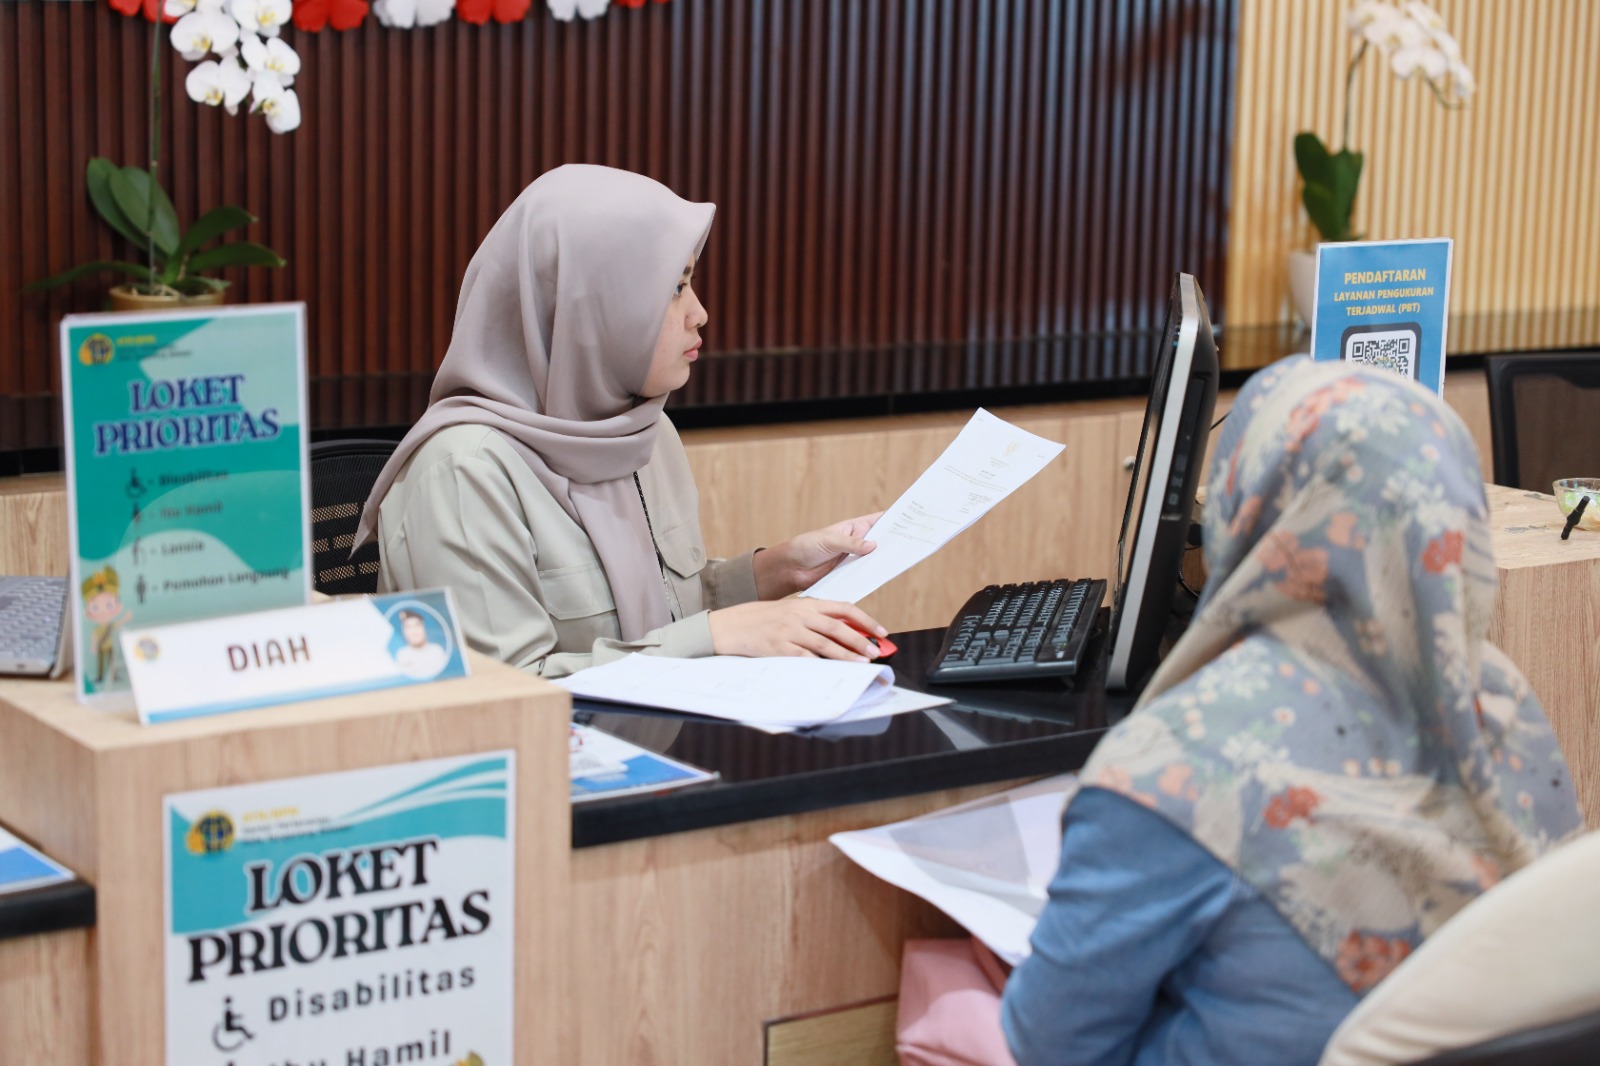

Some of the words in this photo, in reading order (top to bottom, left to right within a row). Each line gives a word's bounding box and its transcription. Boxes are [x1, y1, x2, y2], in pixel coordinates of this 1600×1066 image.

[1334, 291, 1375, 301] LAYANAN
[1378, 287, 1433, 298] PENGUKURAN
[1345, 269, 1426, 284] PENDAFTARAN
[1347, 304, 1395, 315] TERJADWAL
[1398, 303, 1420, 314] (PBT)
[129, 374, 245, 414] LOKET
[94, 409, 280, 456] PRIORITAS
[227, 636, 310, 671] DIAH
[248, 839, 438, 913] LOKET
[187, 890, 491, 984] PRIORITAS
[269, 966, 475, 1022] Disabilitas
[347, 1030, 451, 1066] Hamil
